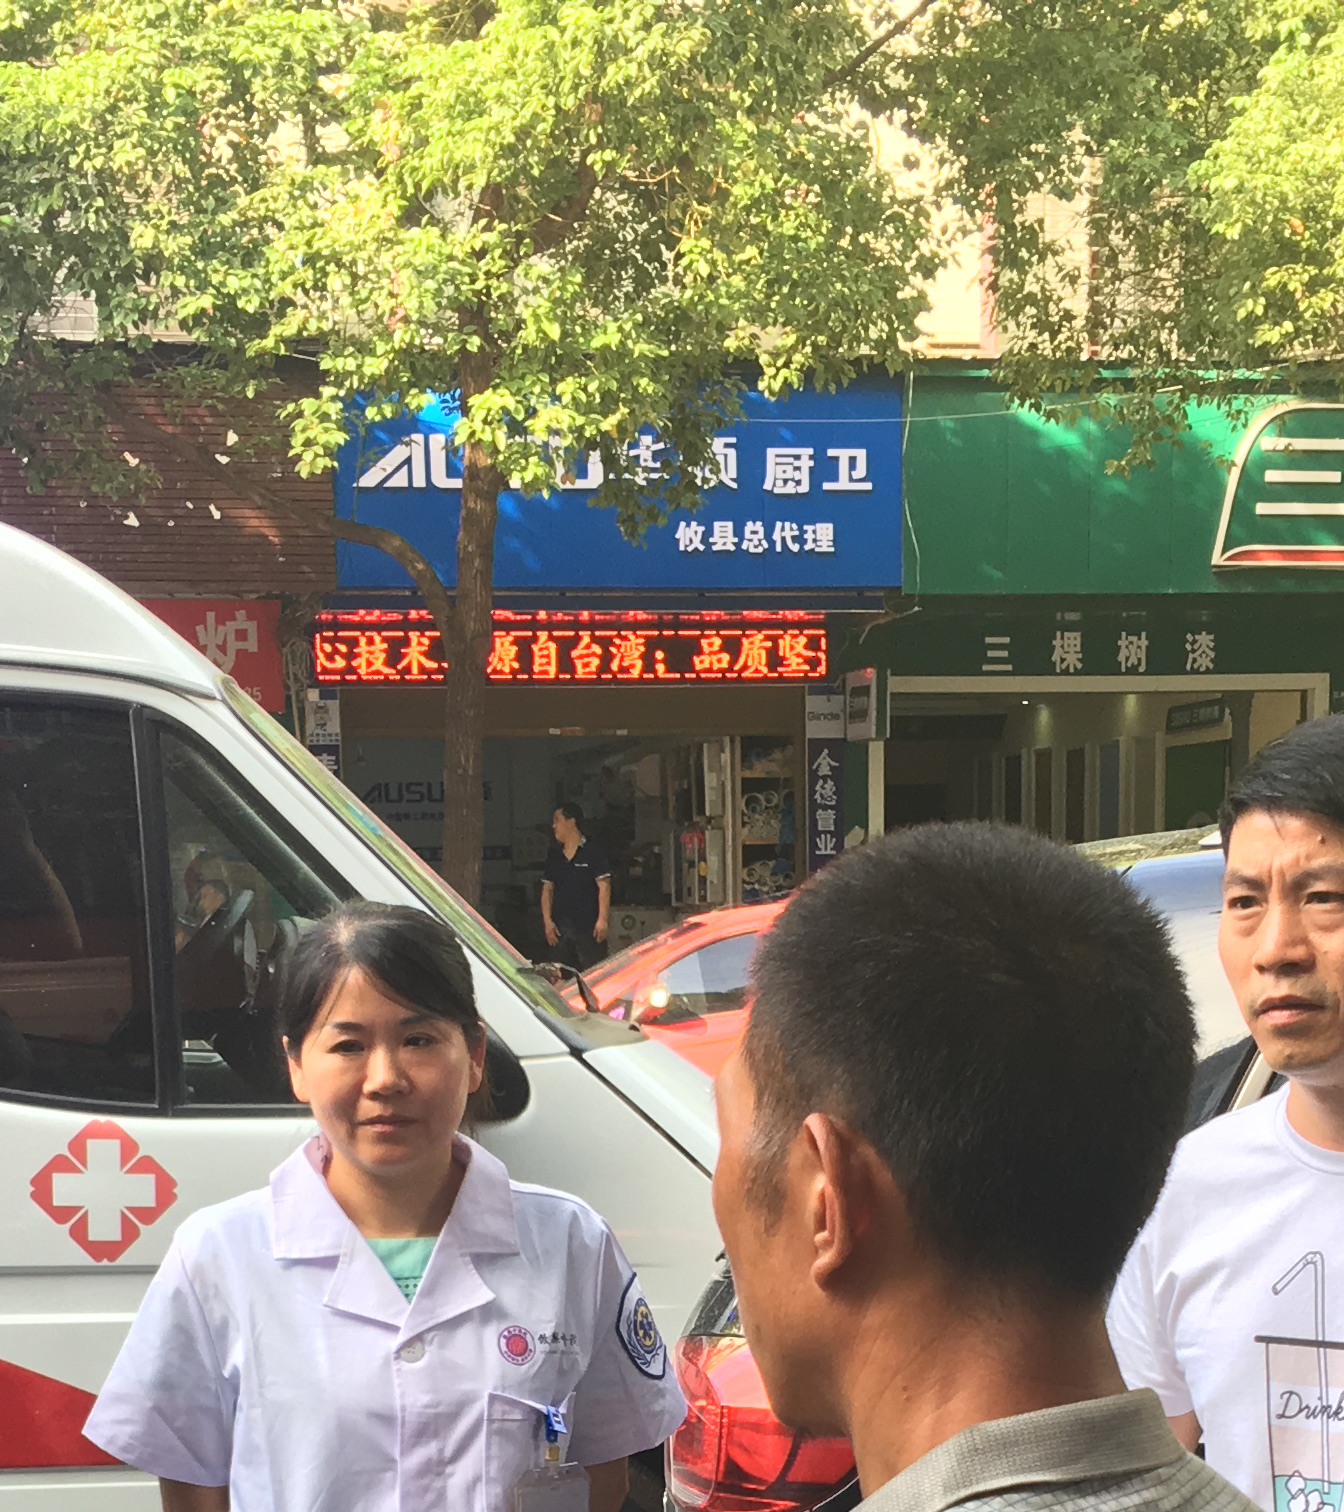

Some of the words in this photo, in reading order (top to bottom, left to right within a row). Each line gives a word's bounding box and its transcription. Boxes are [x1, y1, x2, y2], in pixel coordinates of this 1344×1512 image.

[762, 446, 873, 494] 厨卫
[675, 520, 835, 553] 攸县总代理
[318, 634, 815, 677] 心技术源自台湾；品质坚
[981, 631, 1216, 673] 三棵树漆
[812, 747, 840, 855] 金德管业
